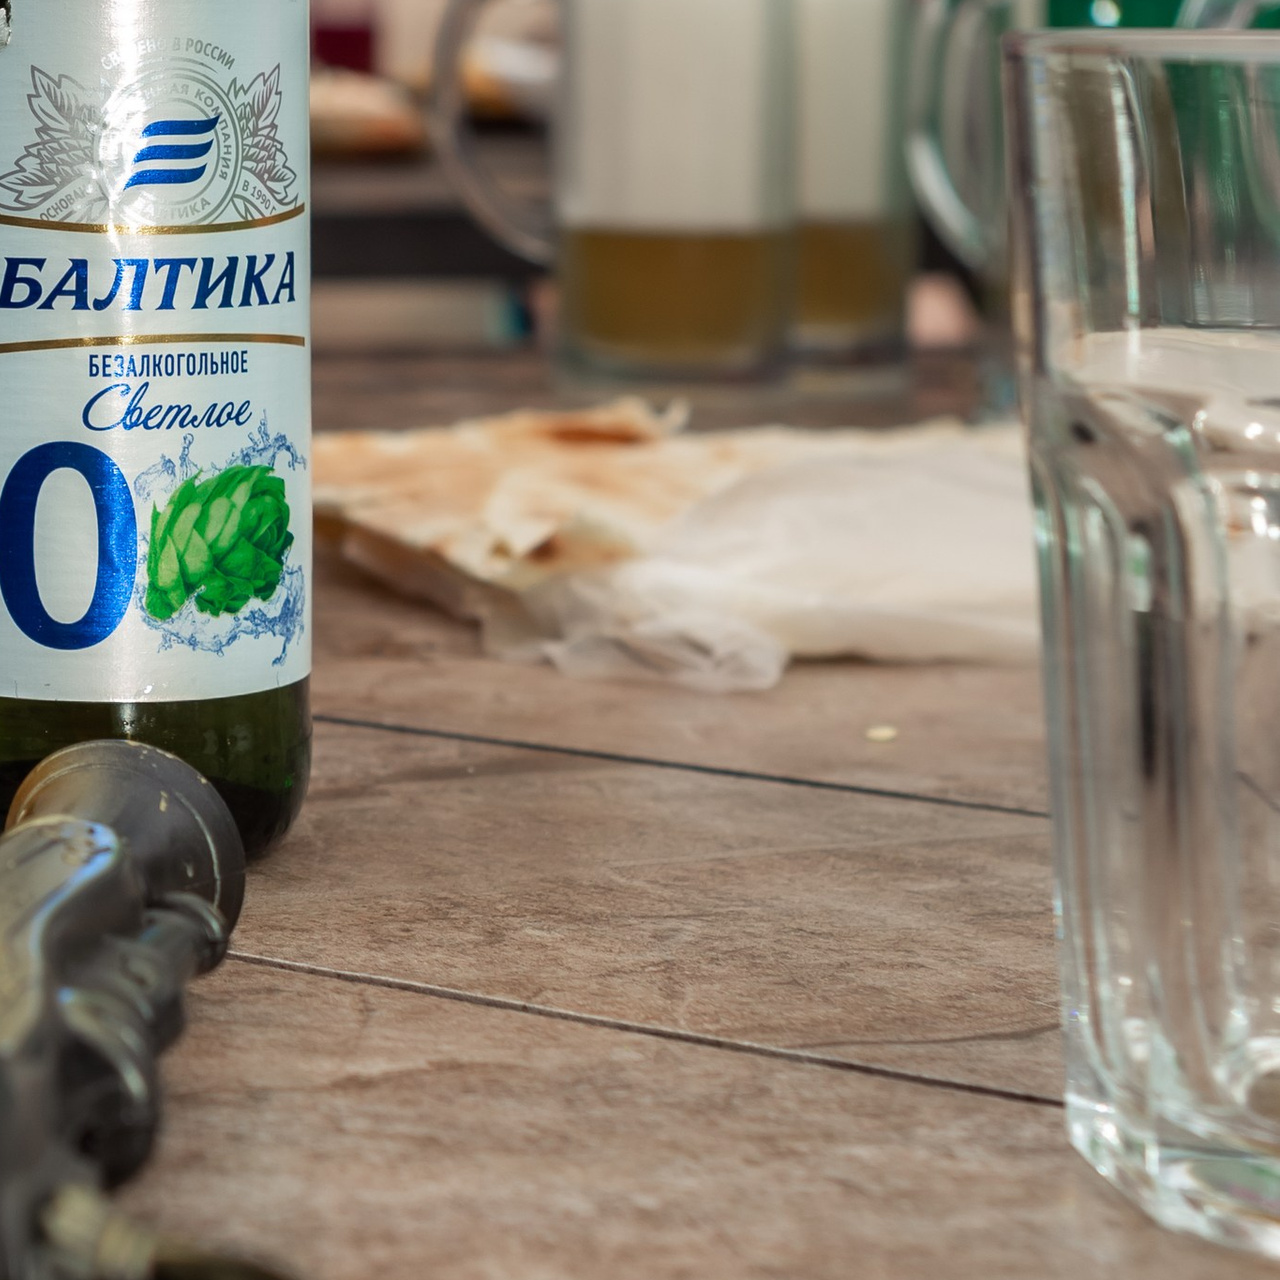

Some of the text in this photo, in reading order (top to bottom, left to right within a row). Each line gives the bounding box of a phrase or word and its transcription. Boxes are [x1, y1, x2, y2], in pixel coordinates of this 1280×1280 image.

[101, 38, 167, 70] СВЕНО
[186, 37, 236, 70] РОССИИ
[194, 87, 233, 181] КОМПАНИЯ
[242, 179, 250, 192] В
[250, 186, 271, 210] 1990
[88, 350, 248, 378] БЕЗАЛКОГОЛЬНОЕ
[82, 381, 253, 432] Светлое
